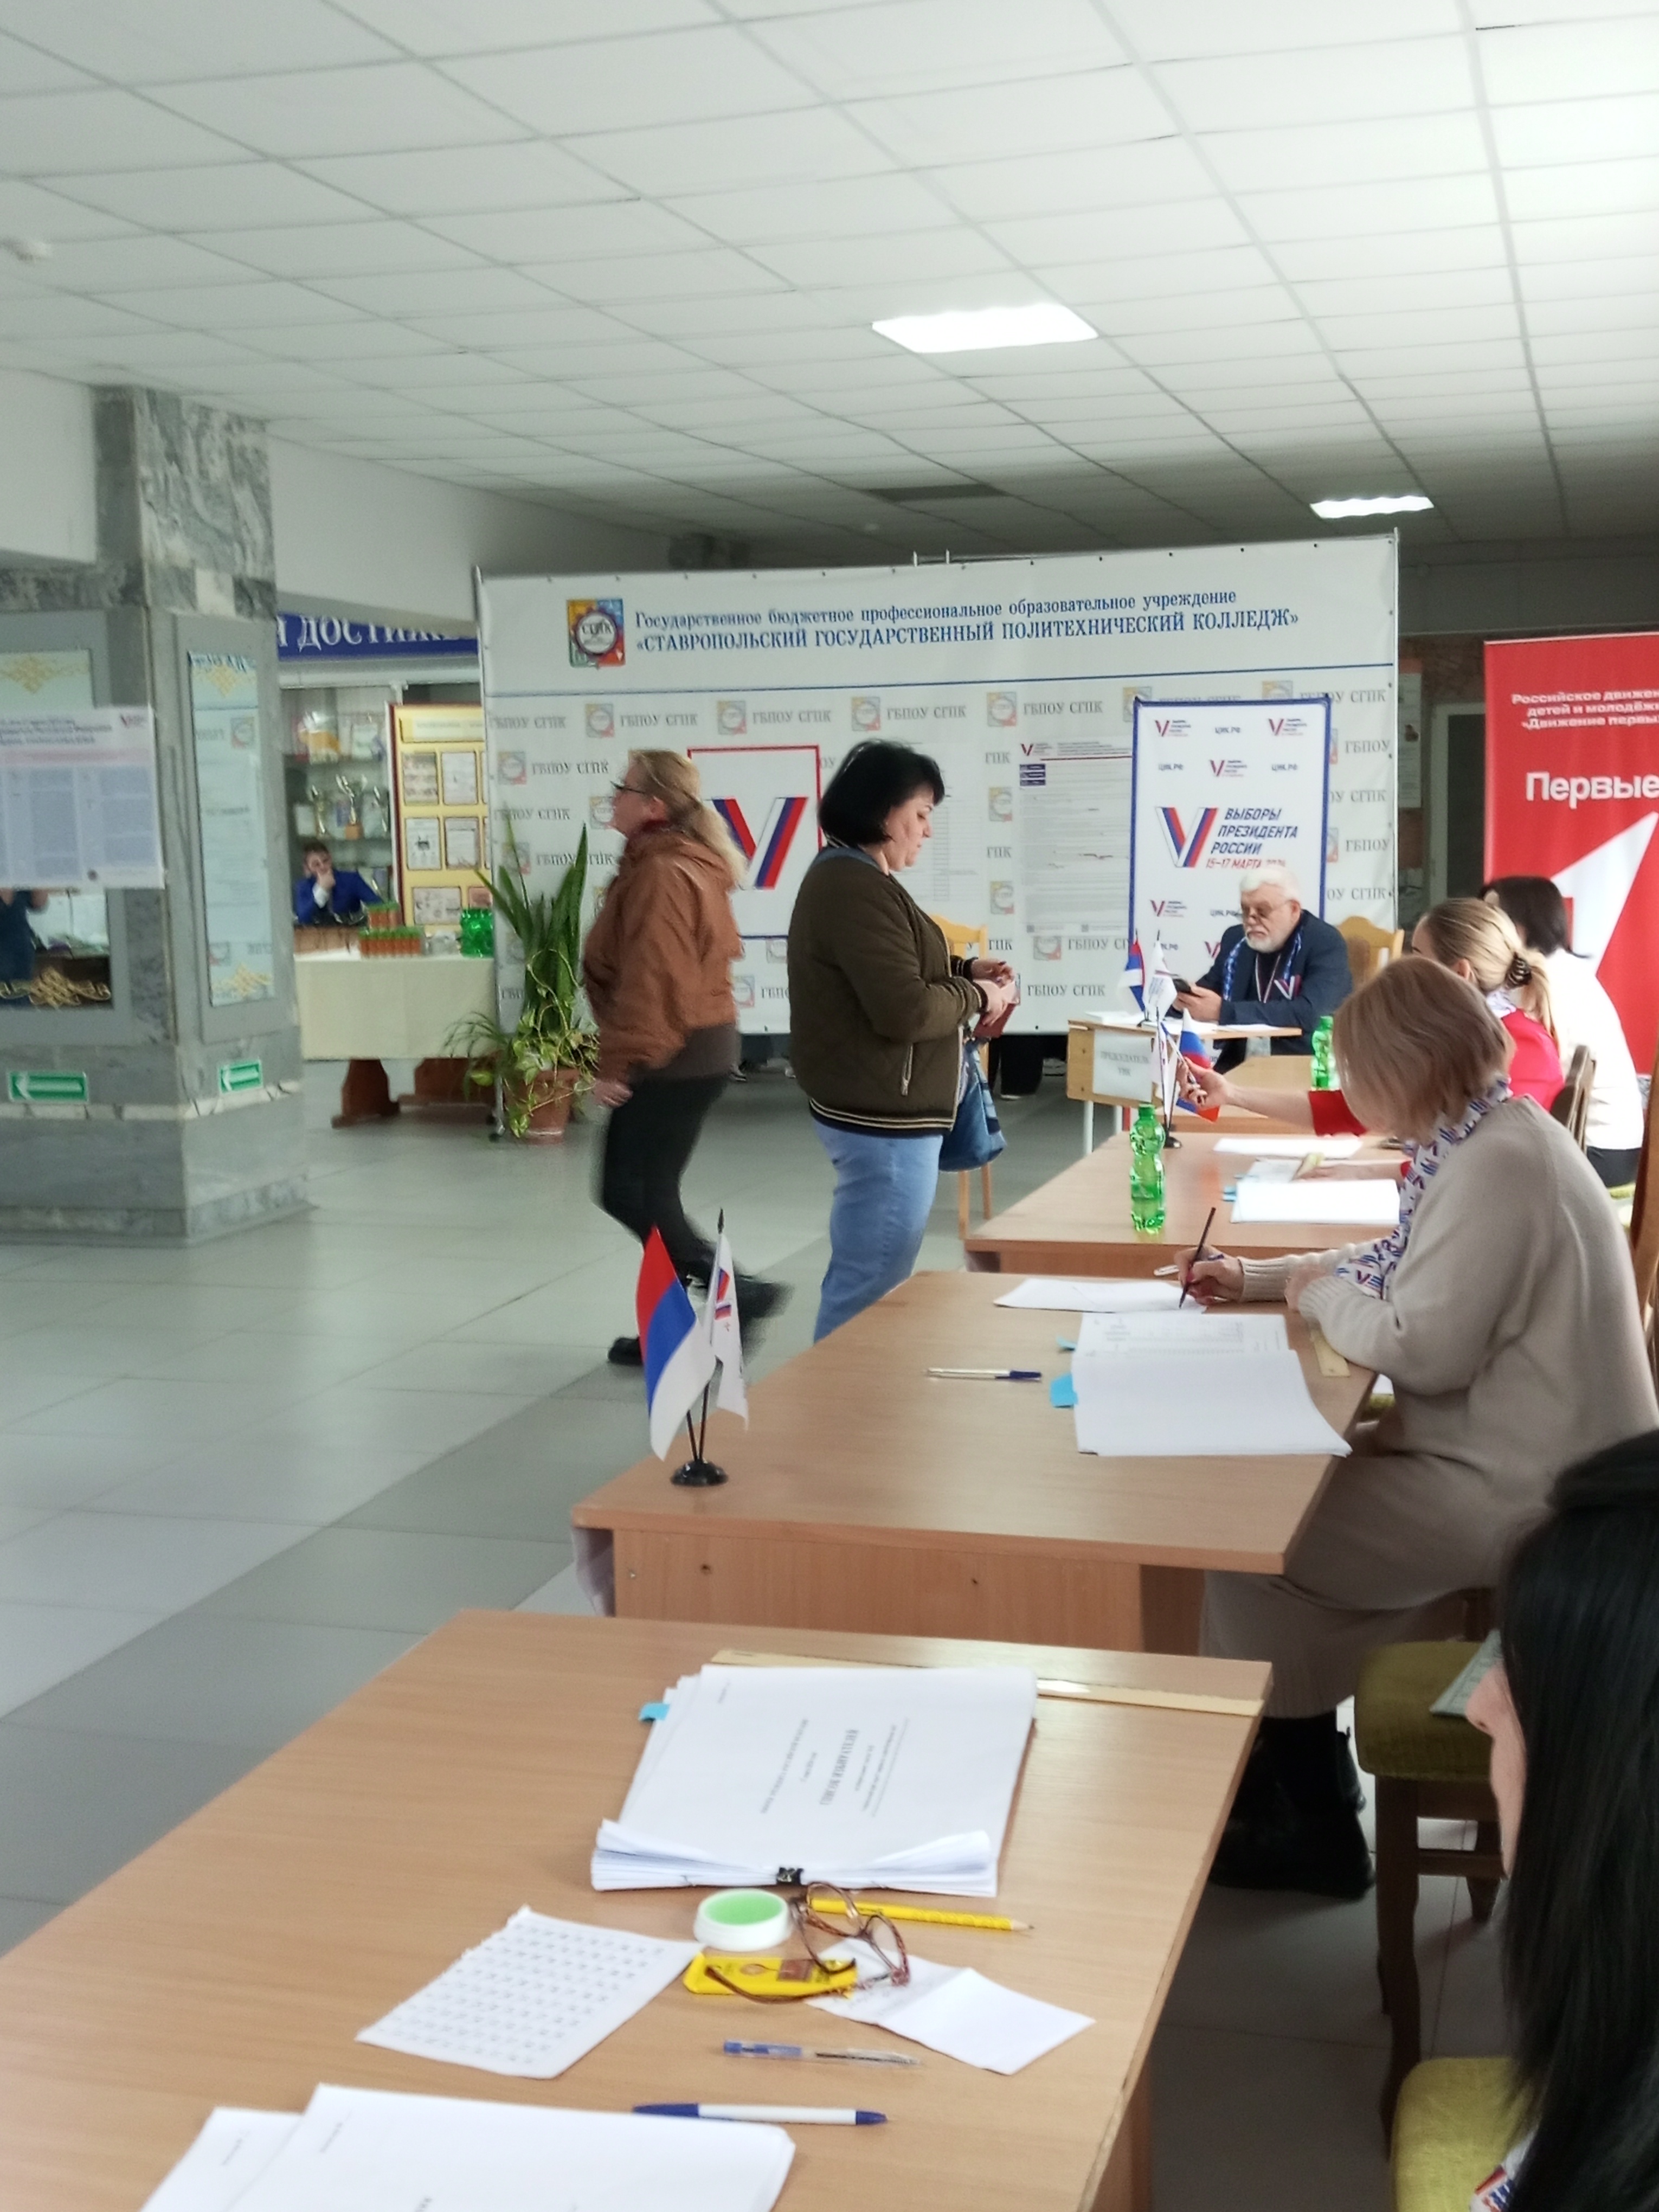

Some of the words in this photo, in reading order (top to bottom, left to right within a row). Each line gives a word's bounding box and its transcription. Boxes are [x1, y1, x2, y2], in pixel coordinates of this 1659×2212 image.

[635, 611, 761, 631] Государственное
[768, 608, 853, 626] бюджетное
[861, 604, 1001, 623] профессиональное
[1009, 597, 1135, 617] образовательное
[1143, 591, 1236, 611] учреждение
[637, 628, 807, 651] «СТАВРОПОЛЬСКИЙ
[815, 621, 994, 648] ГОСУДАРСТВЕННЫЙ
[1002, 612, 1184, 639] ПОЛИТЕХНИЧЕСКИЙ
[1193, 608, 1298, 631] КОЛЛЕДЖ»
[1350, 689, 1386, 703] СГПК
[1512, 692, 1601, 704] Российское
[886, 708, 929, 720] ГБПОУ
[934, 705, 967, 718] СГПК
[1023, 702, 1064, 715] ГБПОУ
[1070, 701, 1103, 713] СГПК
[1527, 703, 1570, 717] детей
[1573, 705, 1583, 714] и
[621, 715, 660, 728] ГБПОУ
[666, 713, 698, 726] СГПК
[753, 711, 793, 724] ГБПОУ
[799, 710, 831, 723] СГПК
[1345, 740, 1390, 754] ГБПОУ
[986, 752, 1011, 764] ГПК
[577, 761, 609, 774] СГПК
[1351, 790, 1386, 802] СГПК
[1526, 771, 1659, 809] Первые
[1225, 808, 1282, 820] ВЫБОРЫ
[1218, 825, 1298, 839] ПРЕЗИДЕНТА
[987, 846, 1012, 858] ГПК
[1211, 842, 1262, 855] РОССИИ
[1346, 839, 1389, 852] ГБПОУ
[589, 852, 614, 865] ГПК
[1232, 858, 1262, 868] МАРТА
[1352, 888, 1386, 900] СГПК
[989, 939, 1012, 950] ГПК
[1068, 938, 1110, 950] ГБПОУ
[1027, 985, 1068, 996] ГБПОУ
[1073, 985, 1106, 996] СГПК
